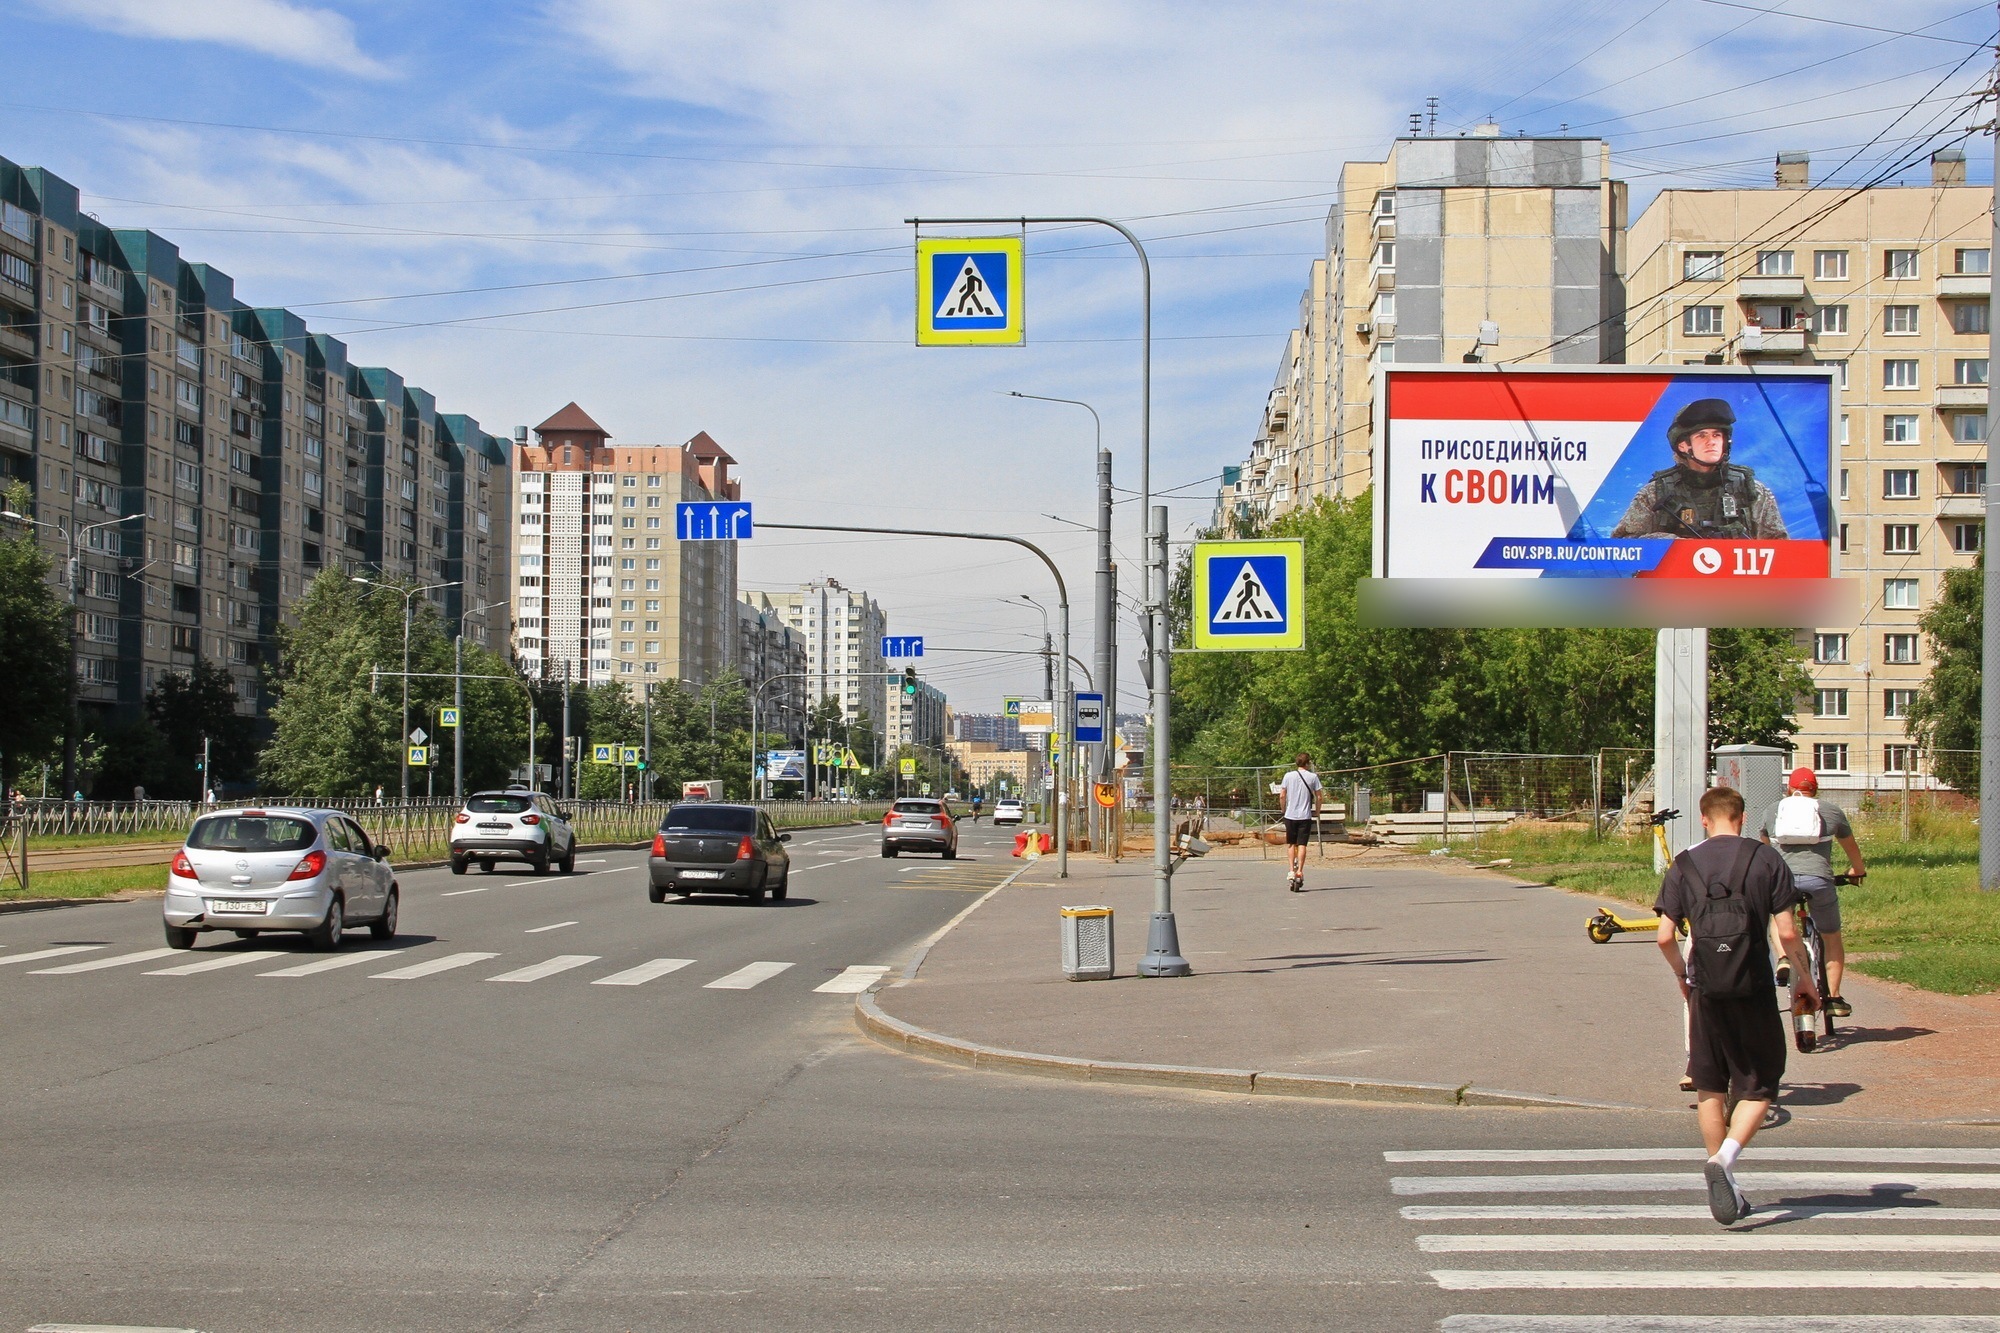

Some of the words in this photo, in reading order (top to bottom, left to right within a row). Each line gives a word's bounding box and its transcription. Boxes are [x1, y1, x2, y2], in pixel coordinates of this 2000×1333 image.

[1421, 437, 1587, 463] ПРИСОЕДИНЯЙСЯ
[1421, 473, 1437, 503] К
[1502, 545, 1642, 561] GOV.SPB.RU/CONTRACT
[1733, 548, 1775, 575] 117
